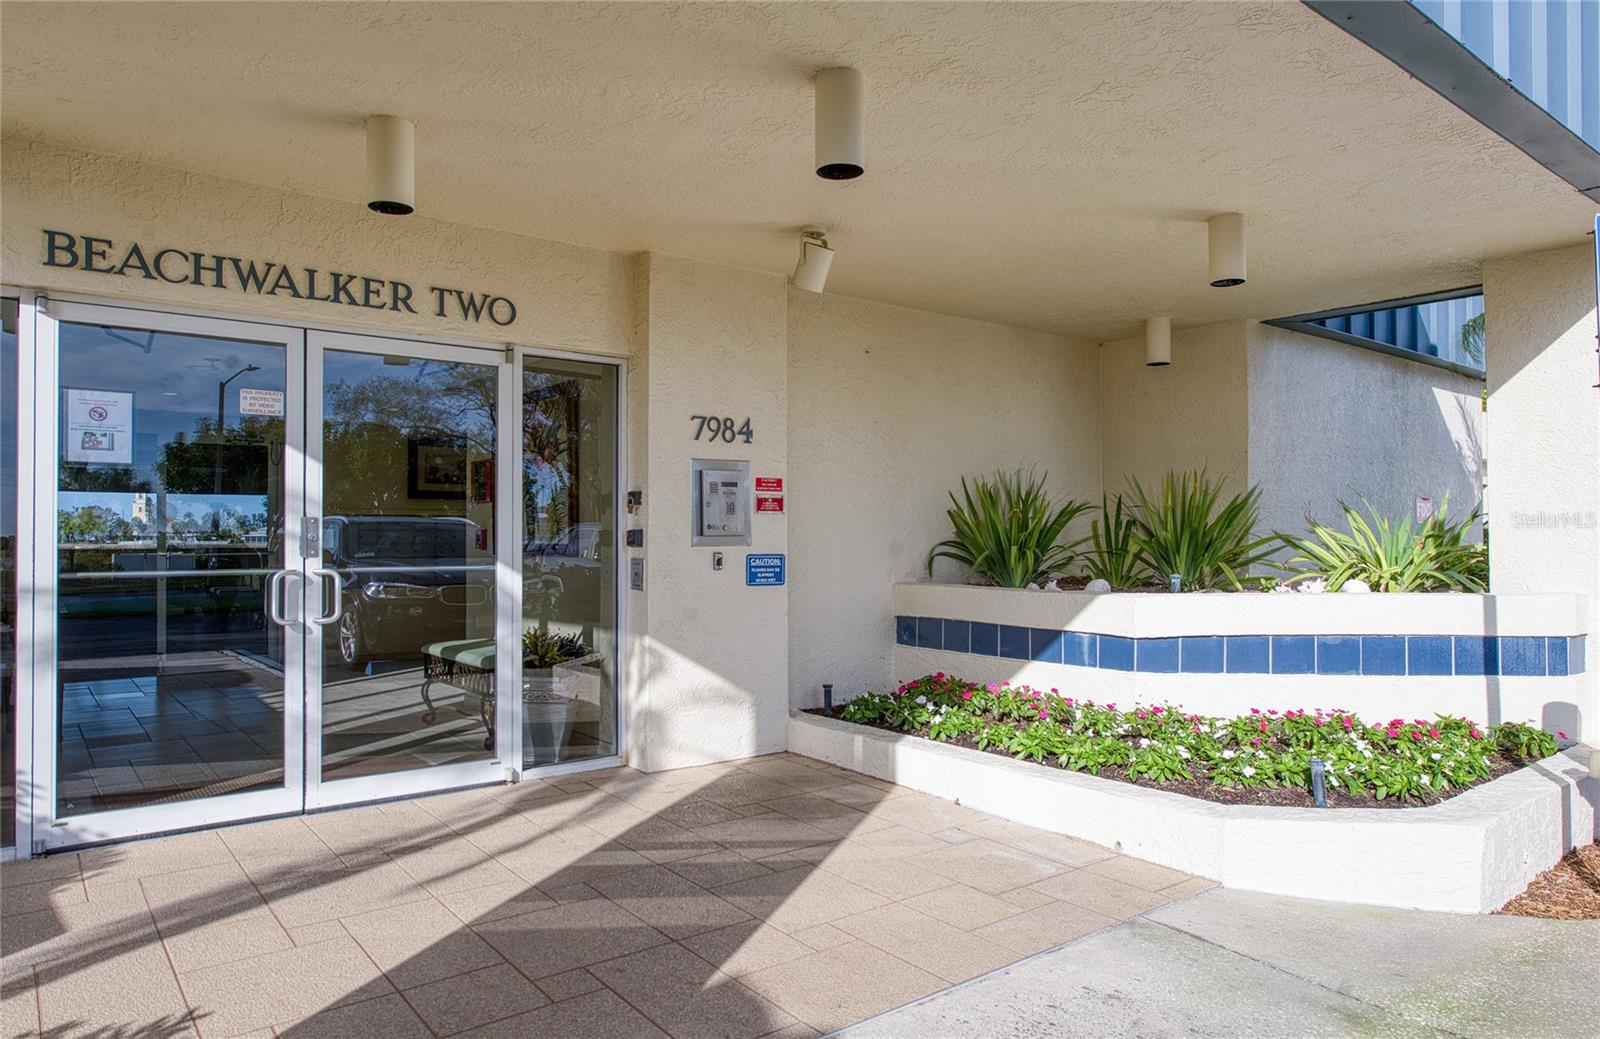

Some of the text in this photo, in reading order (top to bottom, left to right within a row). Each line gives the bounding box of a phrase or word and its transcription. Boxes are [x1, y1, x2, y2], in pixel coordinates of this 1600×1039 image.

[43, 229, 517, 326] BEACHWALKER TWO
[690, 415, 753, 444] 7984
